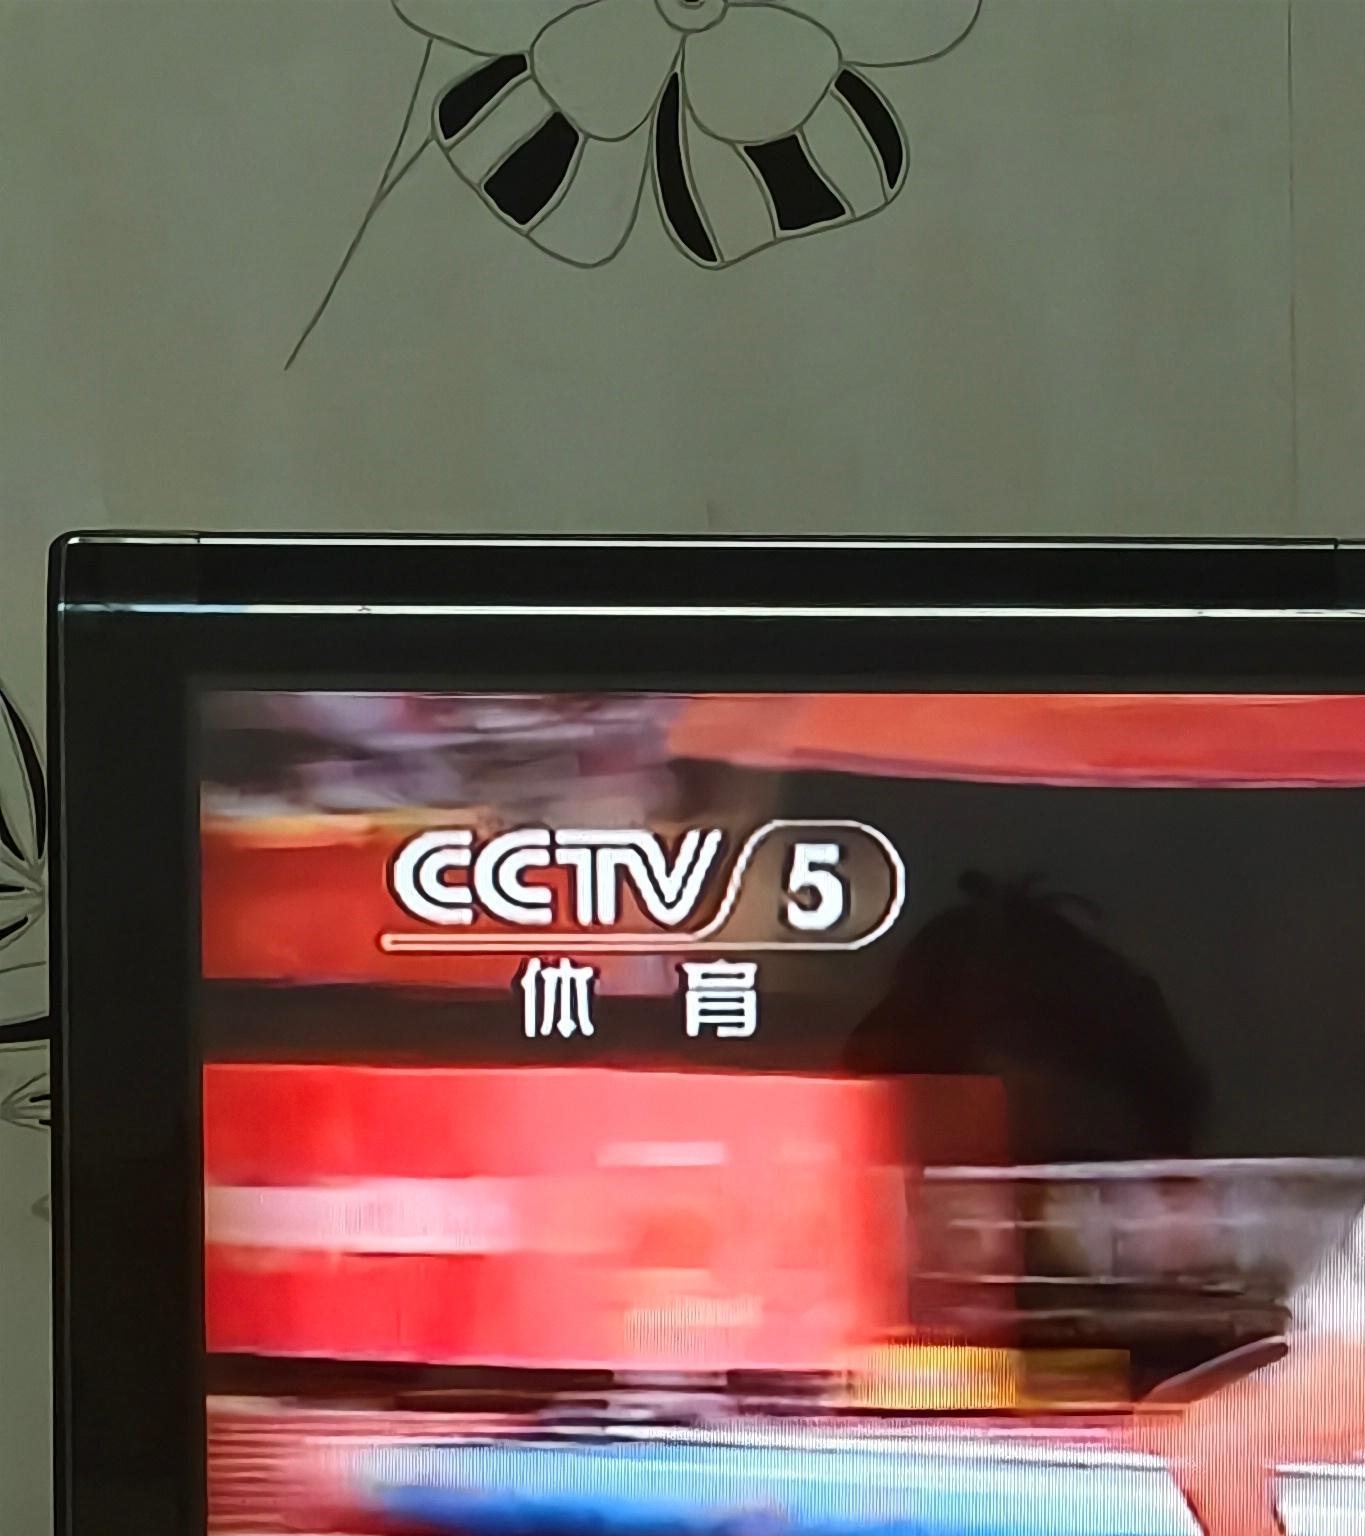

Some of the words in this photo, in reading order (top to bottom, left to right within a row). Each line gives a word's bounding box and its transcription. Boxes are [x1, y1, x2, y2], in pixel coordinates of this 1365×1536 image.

[393, 828, 722, 926] CCTV
[786, 843, 844, 931] 5
[520, 957, 758, 1038] 体育
